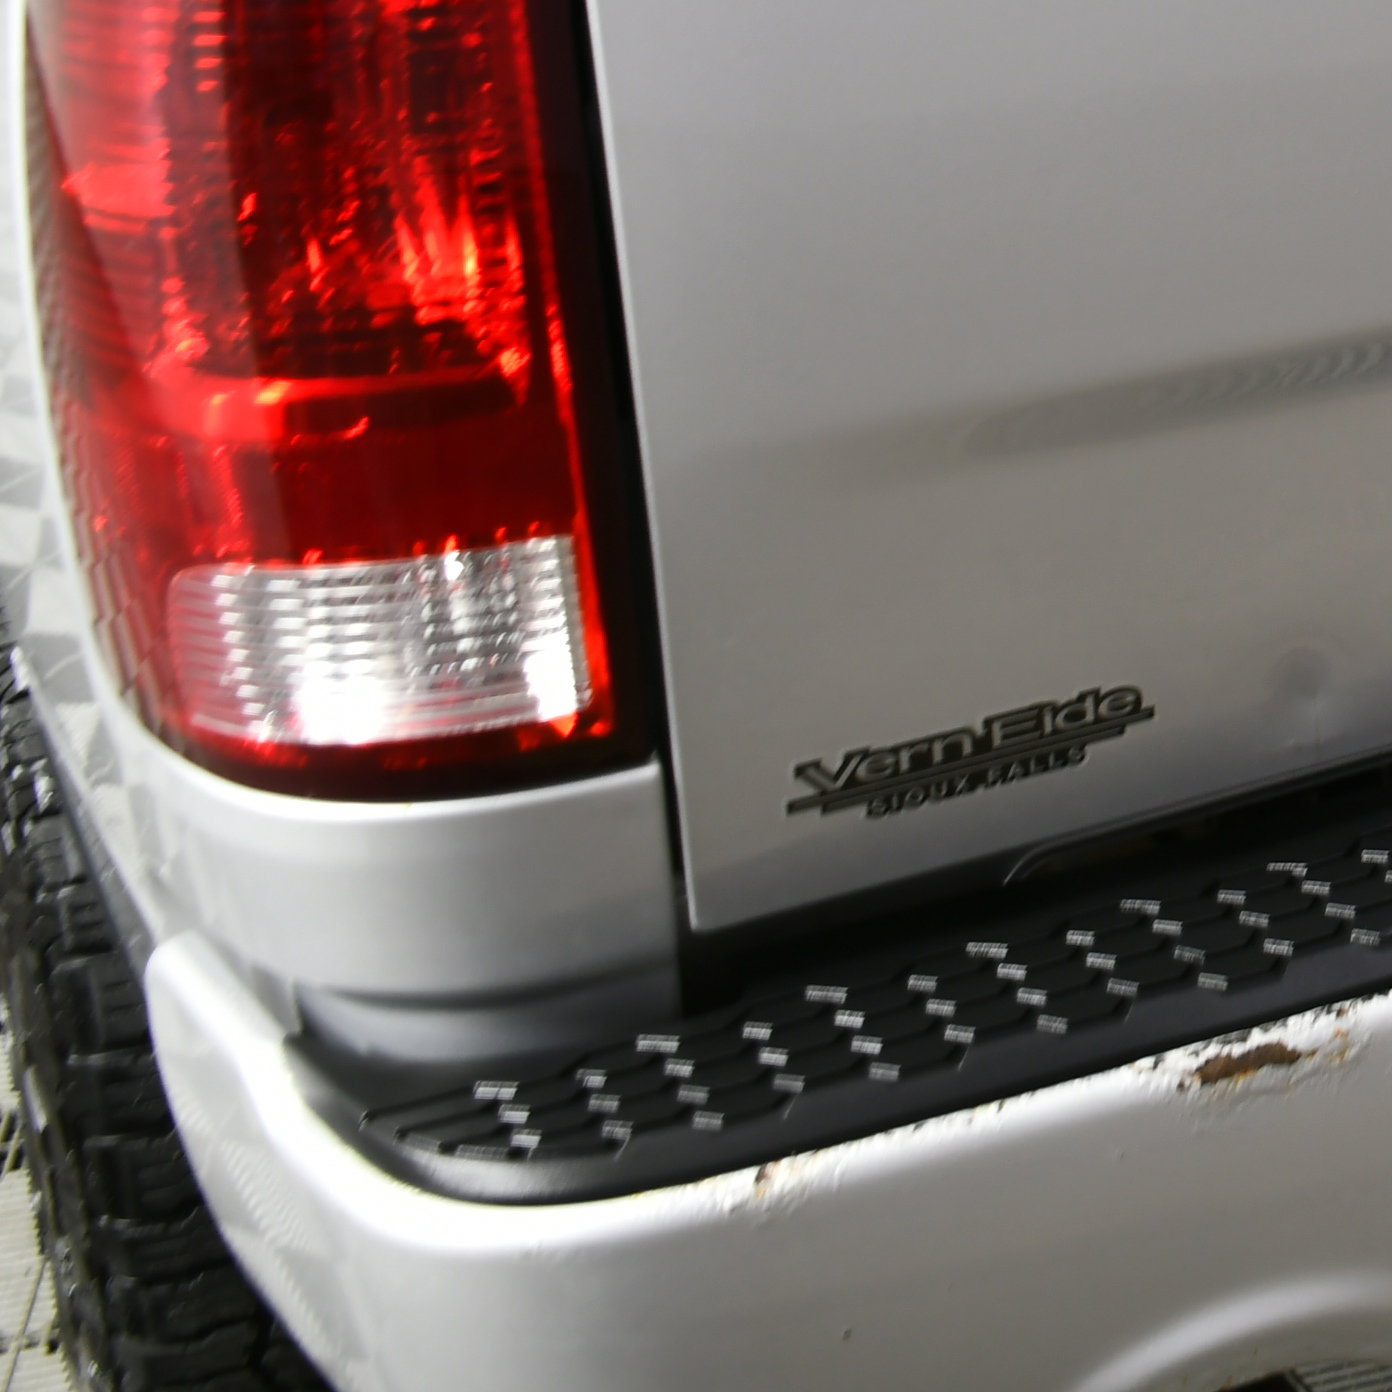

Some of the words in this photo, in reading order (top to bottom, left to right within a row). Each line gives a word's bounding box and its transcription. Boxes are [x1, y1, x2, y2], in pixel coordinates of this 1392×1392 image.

[794, 728, 976, 792] Vern
[982, 684, 1143, 750] Eide
[865, 770, 970, 820] SIOUX
[984, 744, 1088, 788] FALLS
